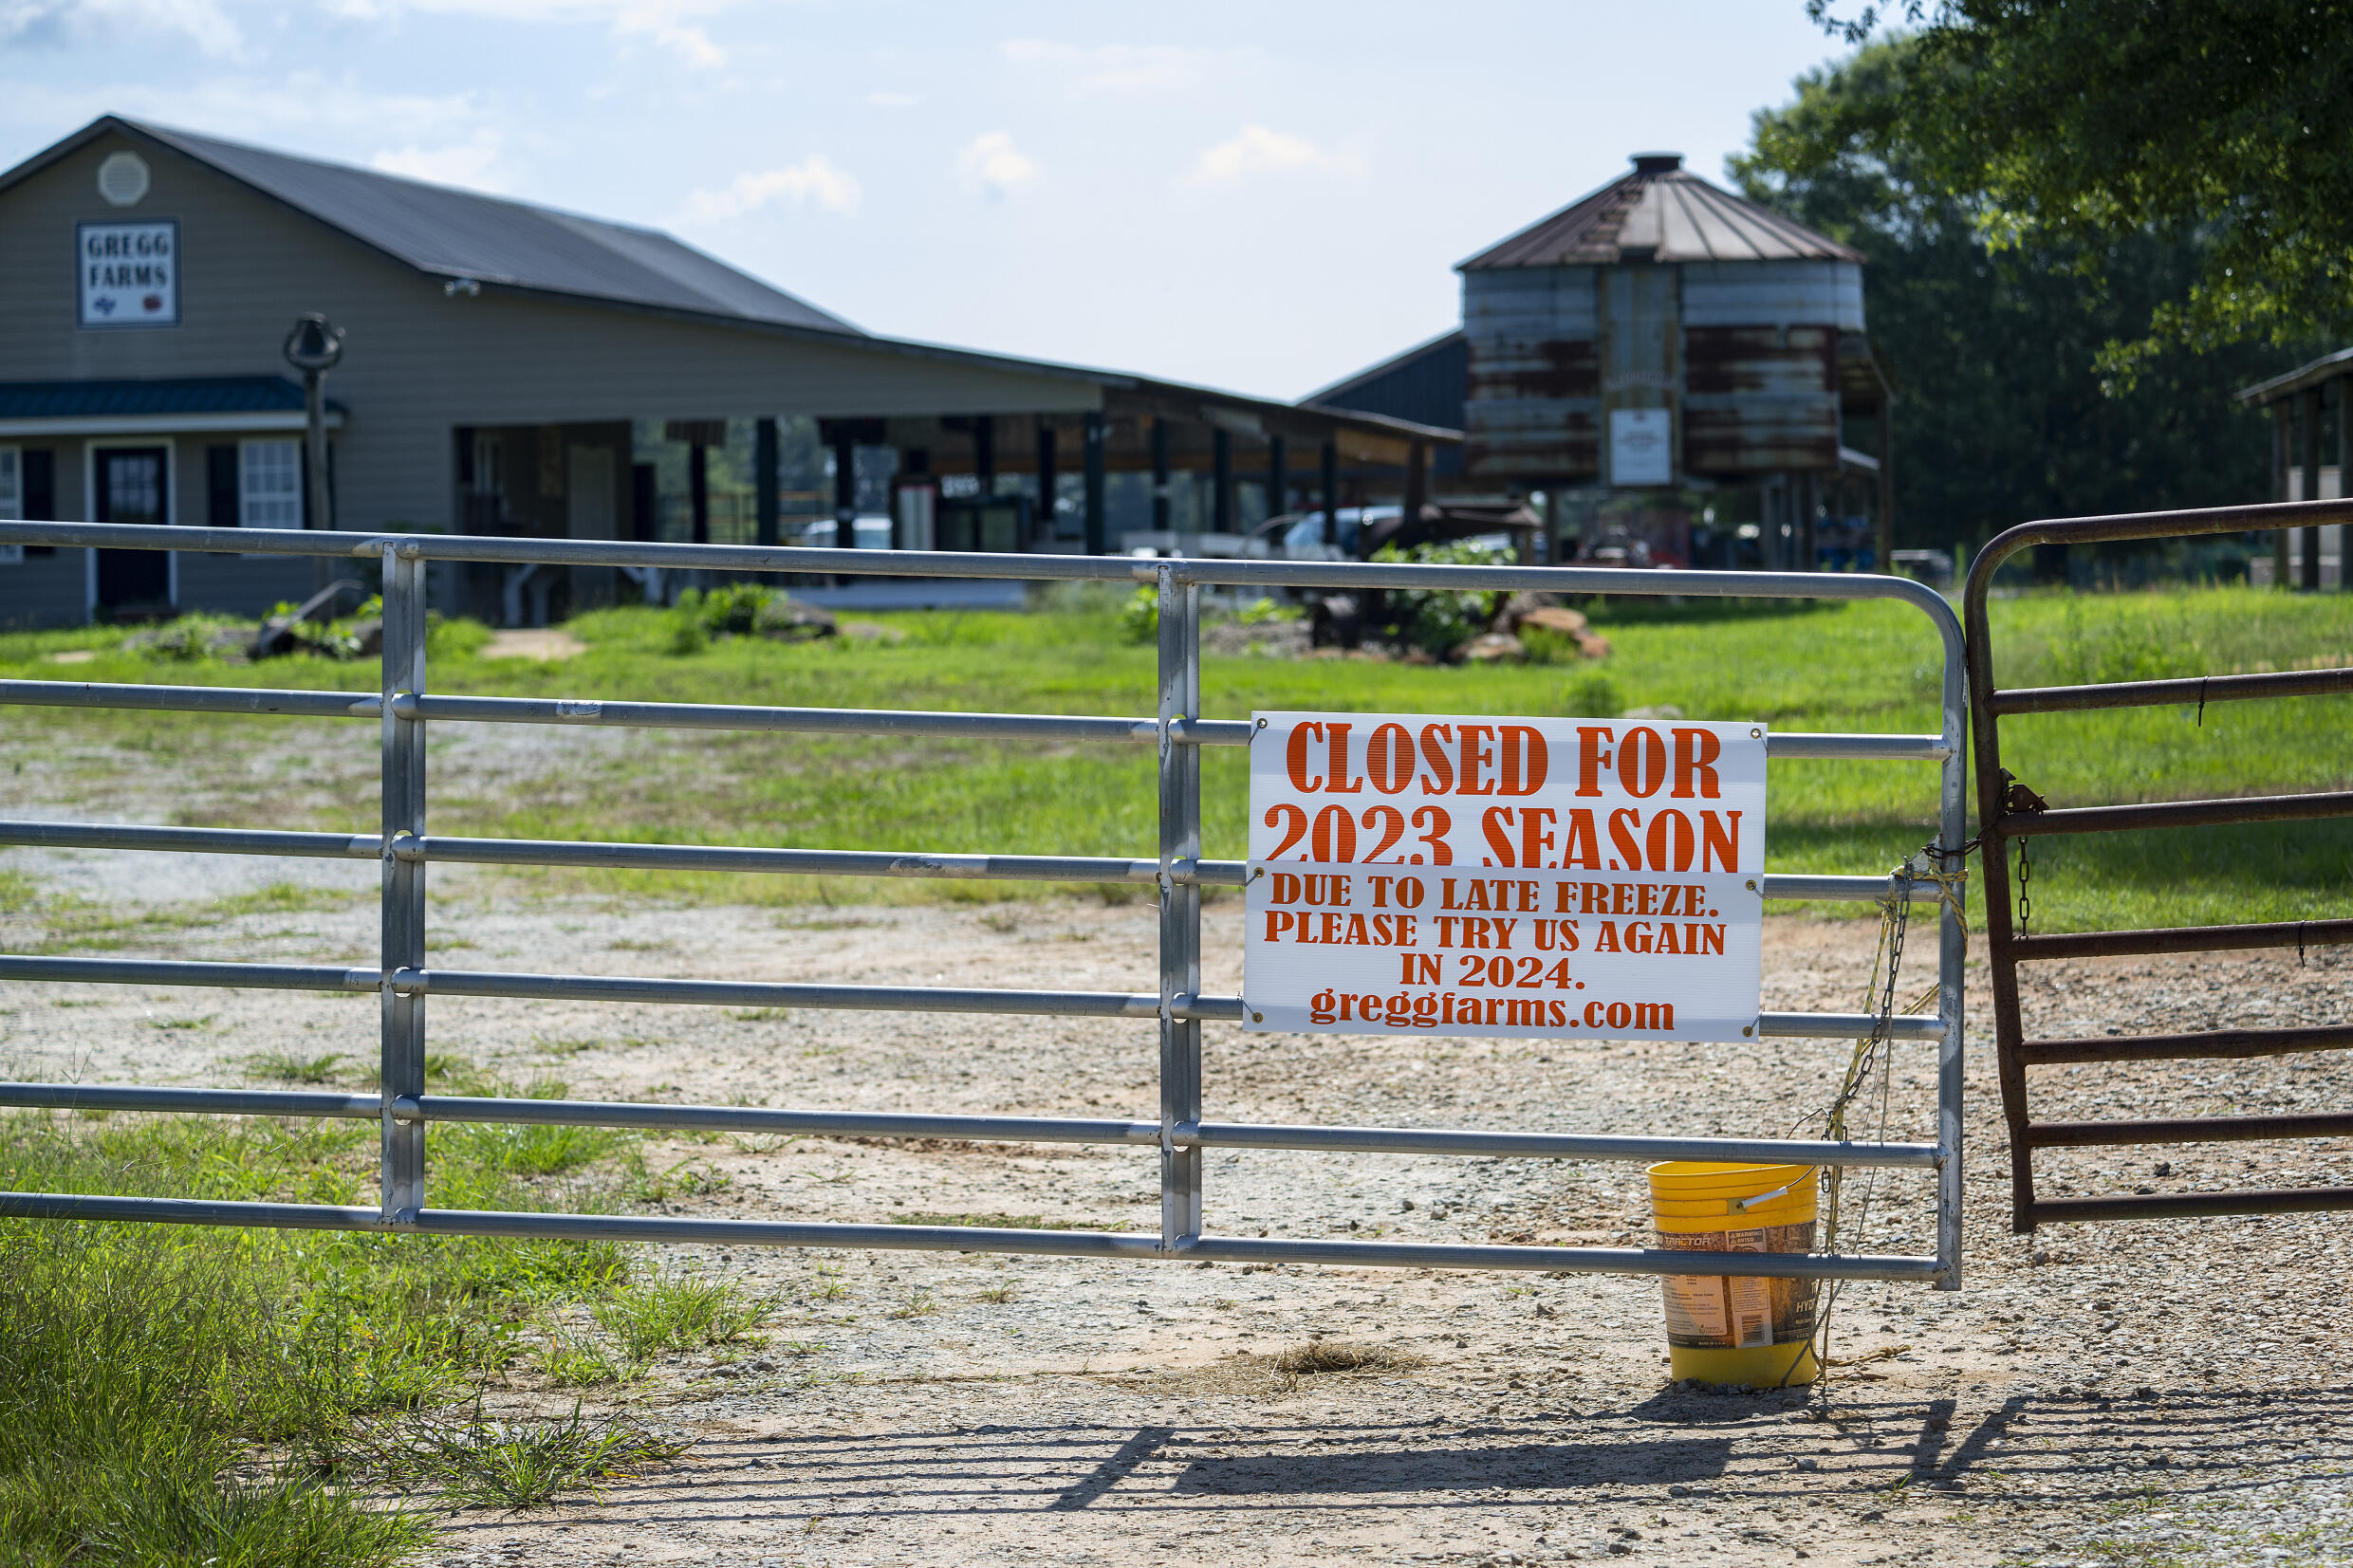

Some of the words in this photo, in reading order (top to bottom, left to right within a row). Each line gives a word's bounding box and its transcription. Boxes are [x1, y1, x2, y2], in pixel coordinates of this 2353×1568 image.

[87, 232, 168, 257] GREGG
[89, 263, 168, 288] FARMS
[1287, 722, 1548, 796] CLOSED
[1575, 727, 1721, 799] FOR
[1264, 803, 1454, 866] 2023
[1482, 805, 1743, 874] SEASON
[1269, 873, 1352, 907] DUE
[1367, 876, 1425, 909] TO
[1440, 878, 1540, 913] LATE
[1554, 881, 1719, 917] FREEZE.
[1264, 910, 1417, 947] PLEASE
[1434, 915, 1518, 950] TRY
[1532, 918, 1580, 952] US
[1594, 921, 1727, 955] AGAIN
[1399, 952, 1443, 986] IN
[1458, 954, 1585, 990] 2024.
[1310, 987, 1675, 1031] greggfarms.com
[1664, 1236, 1712, 1246] TRACTOR
